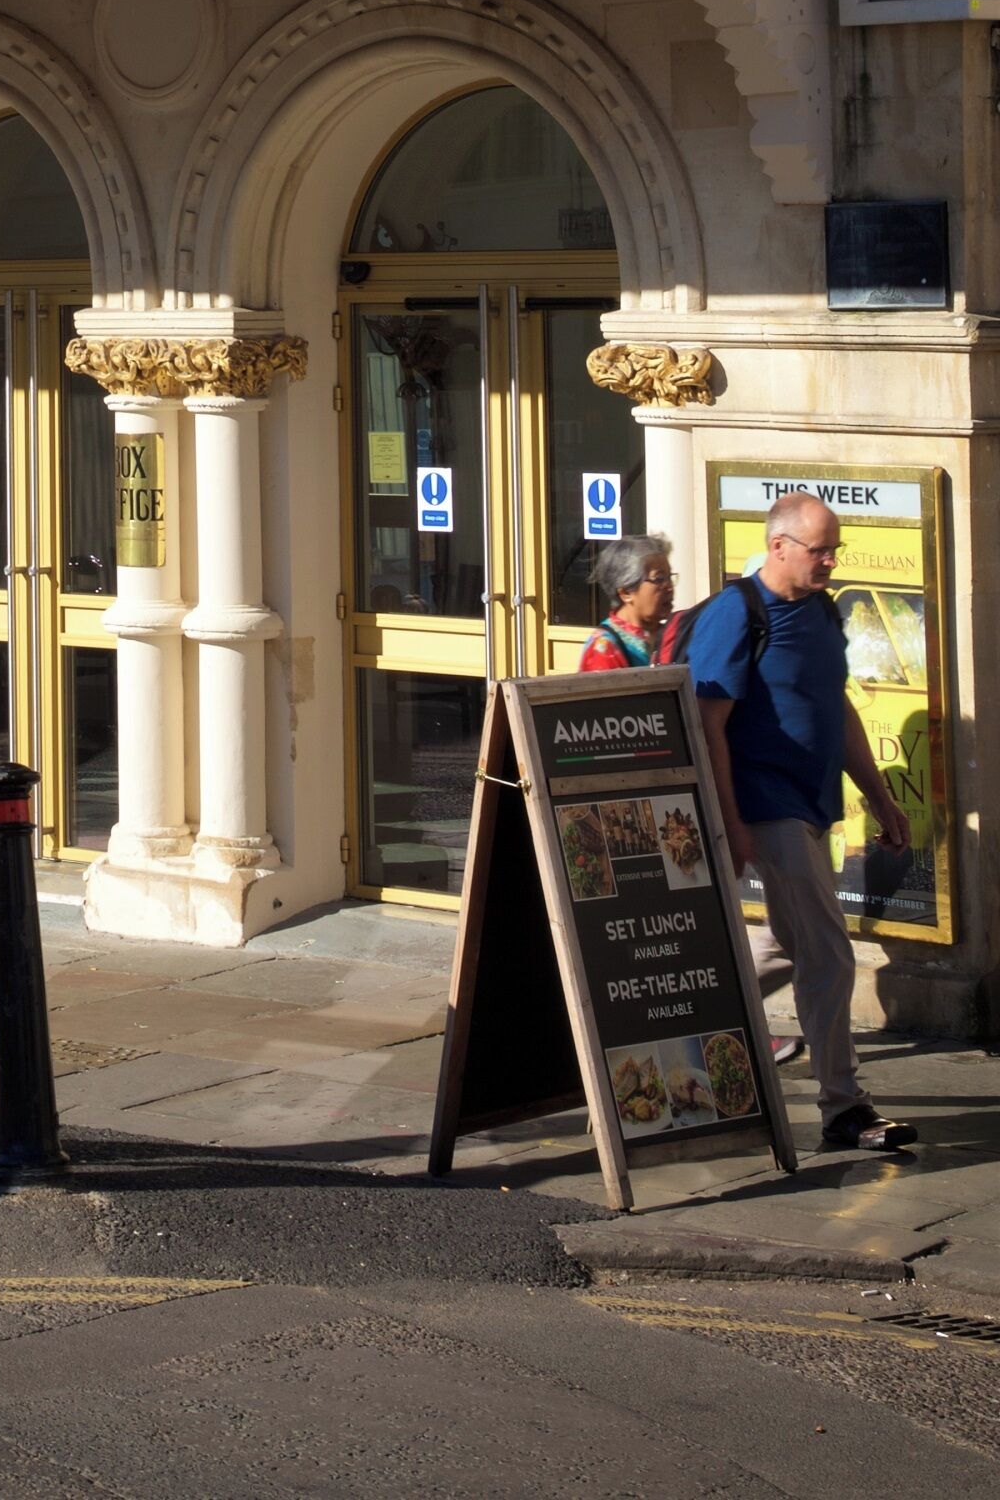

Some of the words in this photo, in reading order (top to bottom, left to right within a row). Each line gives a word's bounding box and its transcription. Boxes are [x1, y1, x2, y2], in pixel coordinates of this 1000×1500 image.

[118, 489, 164, 521] FICE
[816, 485, 879, 505] WEEK
[553, 713, 668, 744] AMARONE
[867, 719, 893, 734] THE
[878, 730, 923, 776] DY
[835, 891, 870, 903] SATURDAY
[882, 897, 925, 910] SEPTEMBER
[605, 918, 636, 941] SET
[642, 910, 696, 937] LUNCH
[634, 942, 680, 960] AVAILABLE
[606, 967, 719, 1002] PRE-THEATRE
[647, 1001, 694, 1020] AVAILABLE
